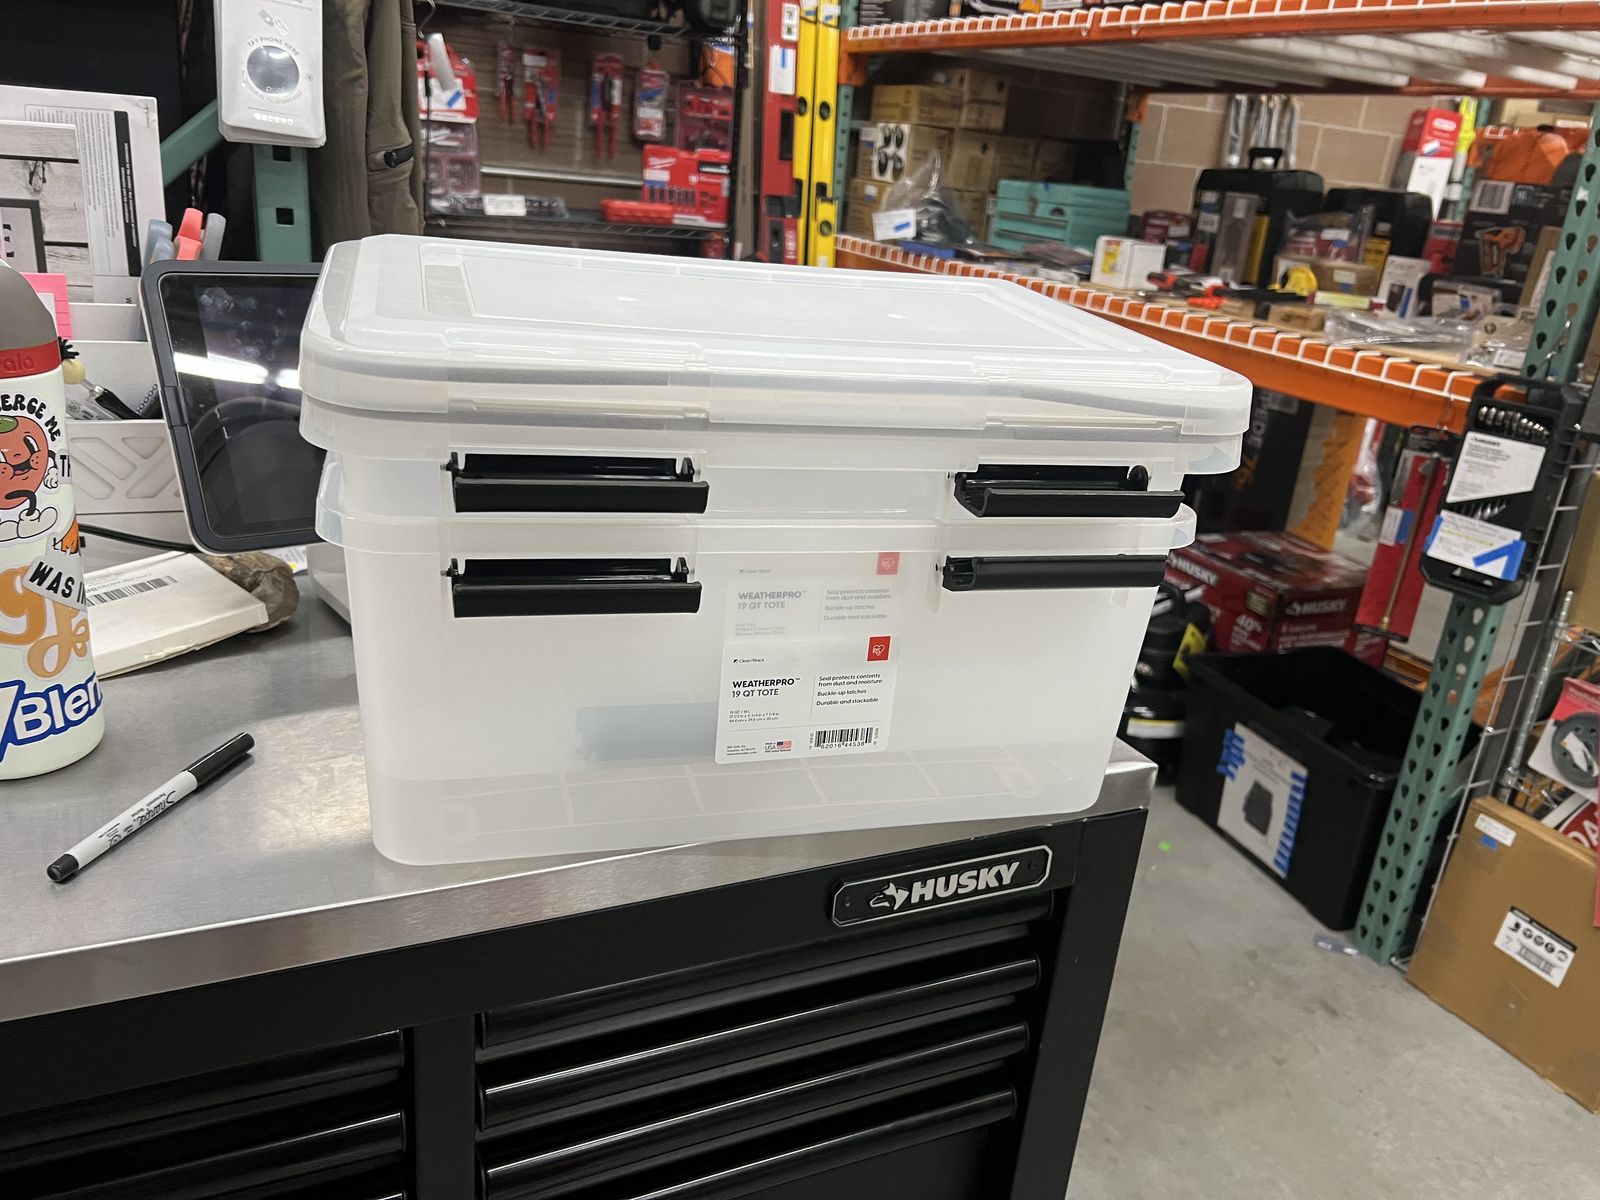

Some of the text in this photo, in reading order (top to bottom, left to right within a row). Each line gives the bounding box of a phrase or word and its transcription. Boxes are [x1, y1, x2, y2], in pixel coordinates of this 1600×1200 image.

[260, 36, 283, 45] PHONE
[0, 353, 34, 372] ala
[45, 415, 61, 442] ME
[1176, 556, 1219, 587] HUSKY
[29, 561, 75, 599] WAS
[738, 601, 786, 610] 19 QT TOTE
[831, 674, 855, 682] protects
[732, 688, 779, 698] 19 QT TOTE
[817, 689, 846, 697] Buckle-up
[910, 861, 1020, 904] HUSKY
